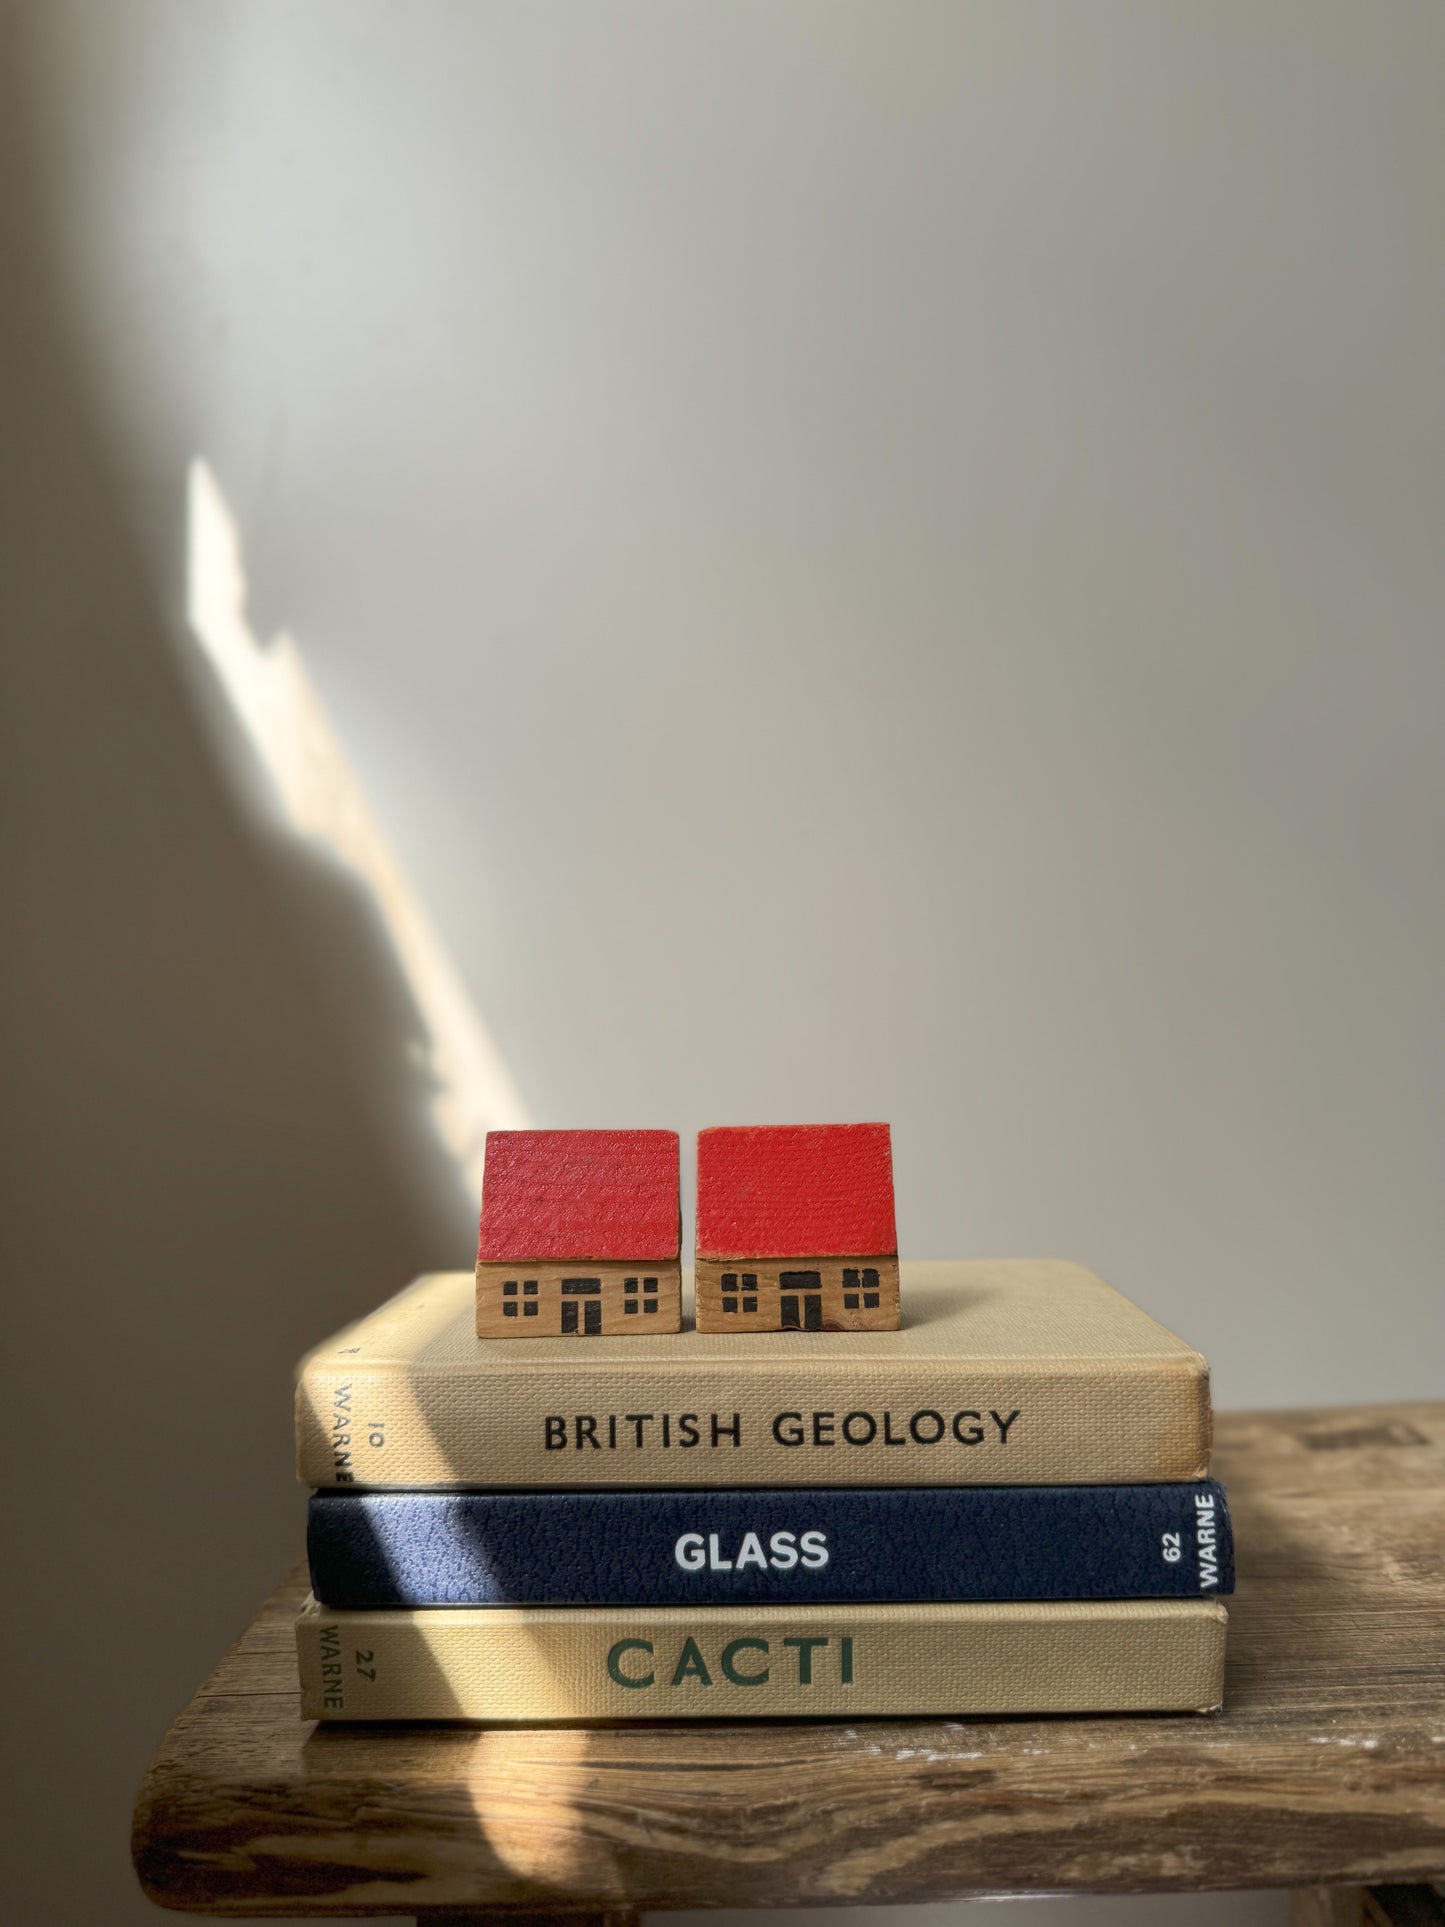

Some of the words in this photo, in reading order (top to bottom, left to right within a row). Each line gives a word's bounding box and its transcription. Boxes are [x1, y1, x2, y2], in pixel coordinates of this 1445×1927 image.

[333, 1383, 354, 1482] WARNE
[368, 1423, 385, 1448] 10
[545, 1413, 740, 1450] BRITISH
[772, 1410, 1021, 1447] GEOLOGY
[674, 1531, 830, 1570] GLASS
[1162, 1532, 1181, 1562] 62
[1194, 1494, 1218, 1588] WARNE
[320, 1624, 344, 1709] WARNE
[356, 1650, 377, 1682] 27
[607, 1636, 854, 1689] CACTI
